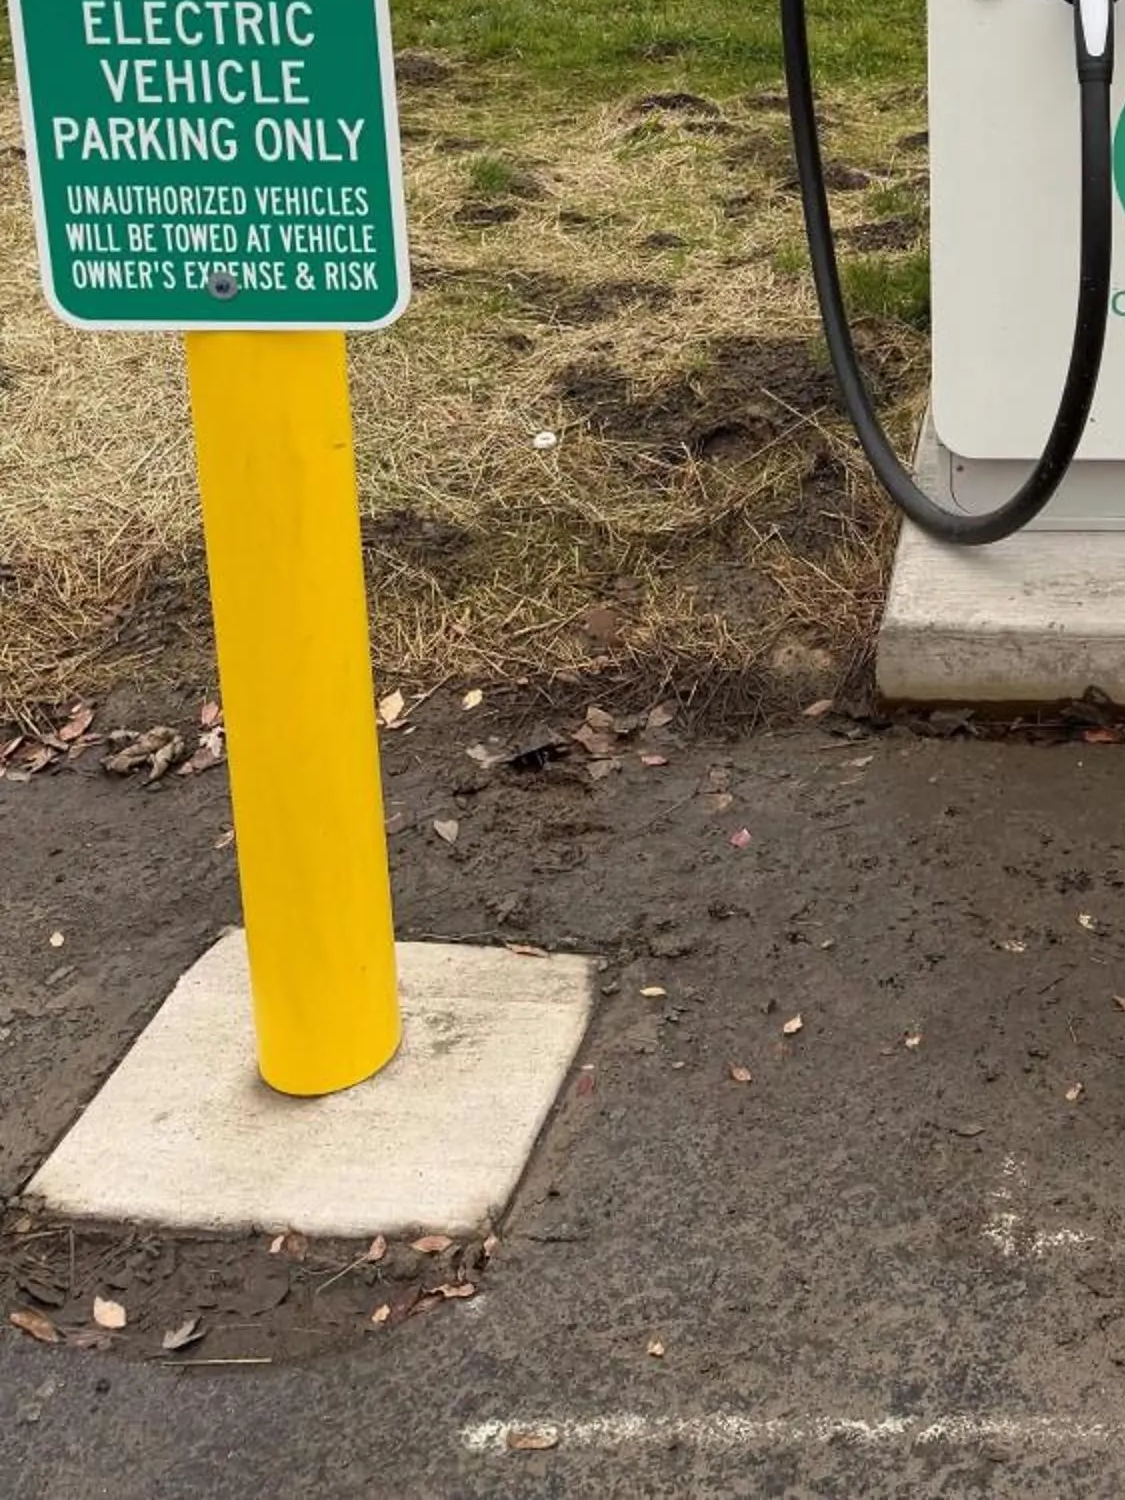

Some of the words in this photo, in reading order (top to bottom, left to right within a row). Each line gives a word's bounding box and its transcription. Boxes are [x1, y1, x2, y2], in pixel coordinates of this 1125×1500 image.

[82, 1, 314, 45] ELECTRIC
[101, 60, 309, 104] VEHICLE
[53, 118, 238, 161] PARKING
[255, 118, 364, 161] ONLY
[67, 186, 247, 215] UNAUTHORIZED
[255, 186, 369, 216] VEHICLES
[66, 224, 121, 252] WILL
[128, 224, 157, 252] BE
[162, 225, 237, 252] TOWED
[247, 225, 271, 252] AT
[279, 225, 376, 253] VEHICLE
[72, 261, 176, 289] OWNER'S
[295, 262, 315, 290] &
[325, 262, 378, 290] RISK
